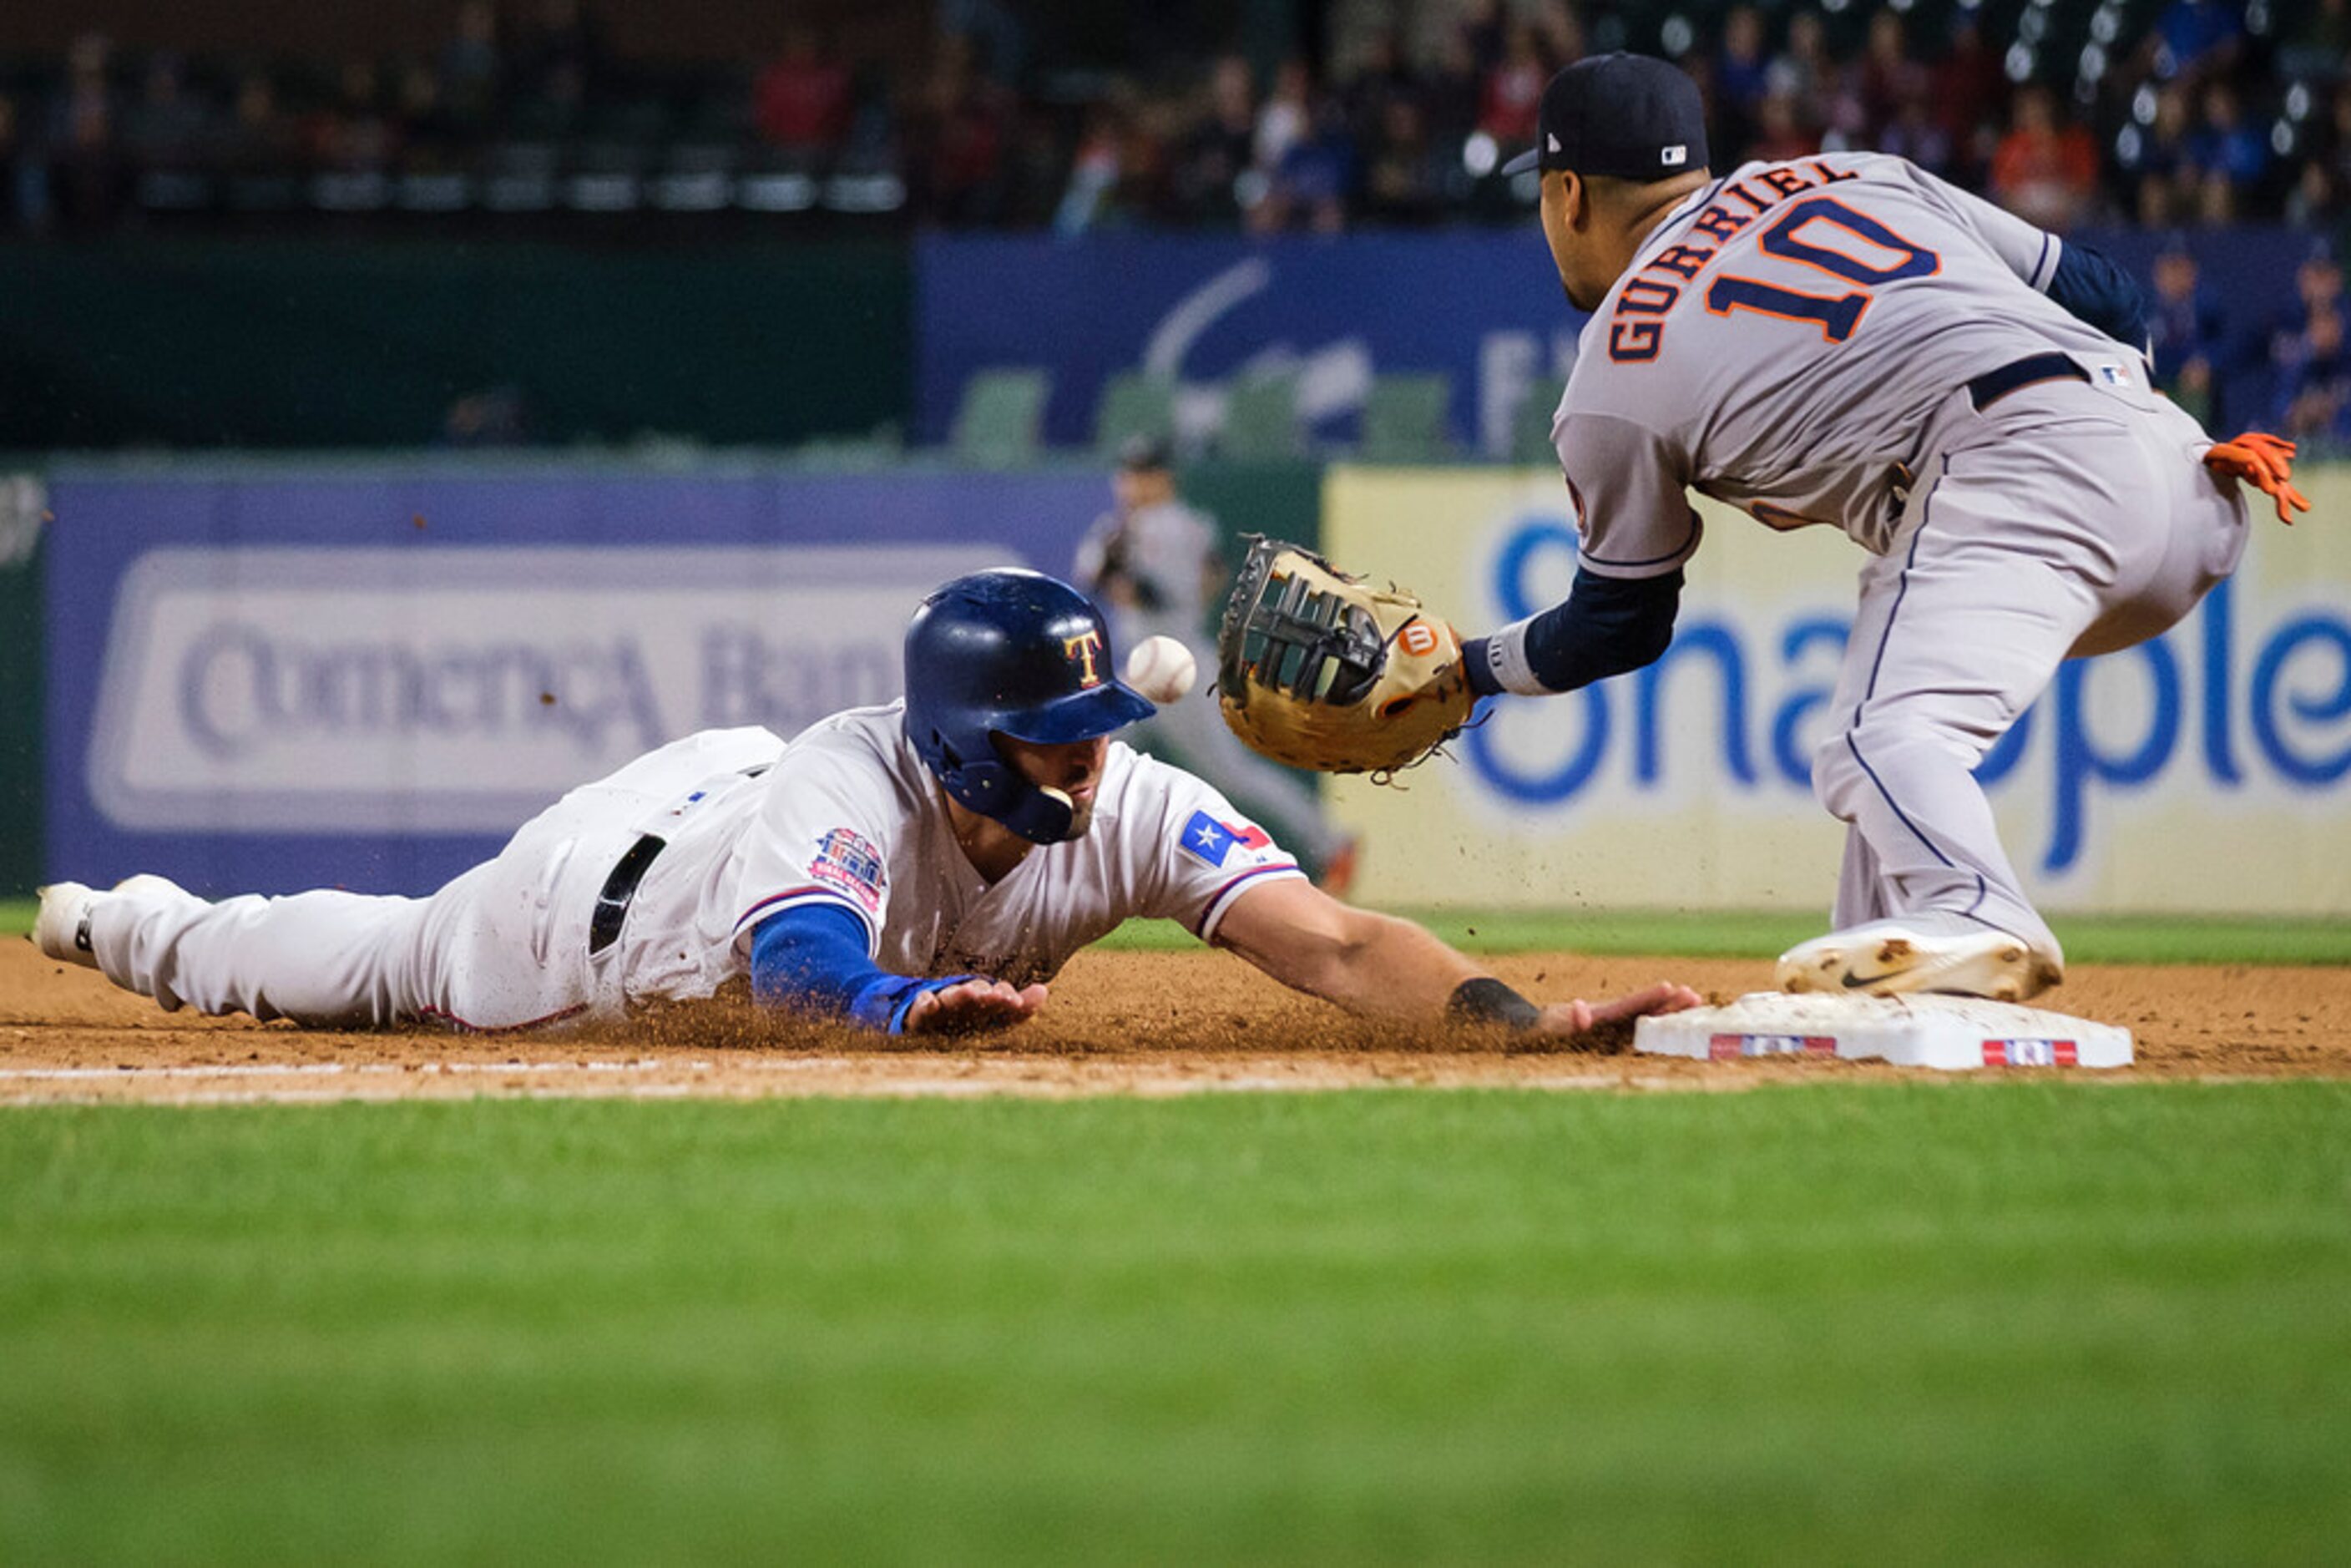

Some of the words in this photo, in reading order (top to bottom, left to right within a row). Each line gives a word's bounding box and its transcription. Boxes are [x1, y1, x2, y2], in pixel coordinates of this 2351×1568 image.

[1609, 161, 1858, 364] GURRIEL
[1704, 195, 1942, 345] 10
[1063, 629, 1102, 690] T
[1464, 519, 2351, 870] Snaple
